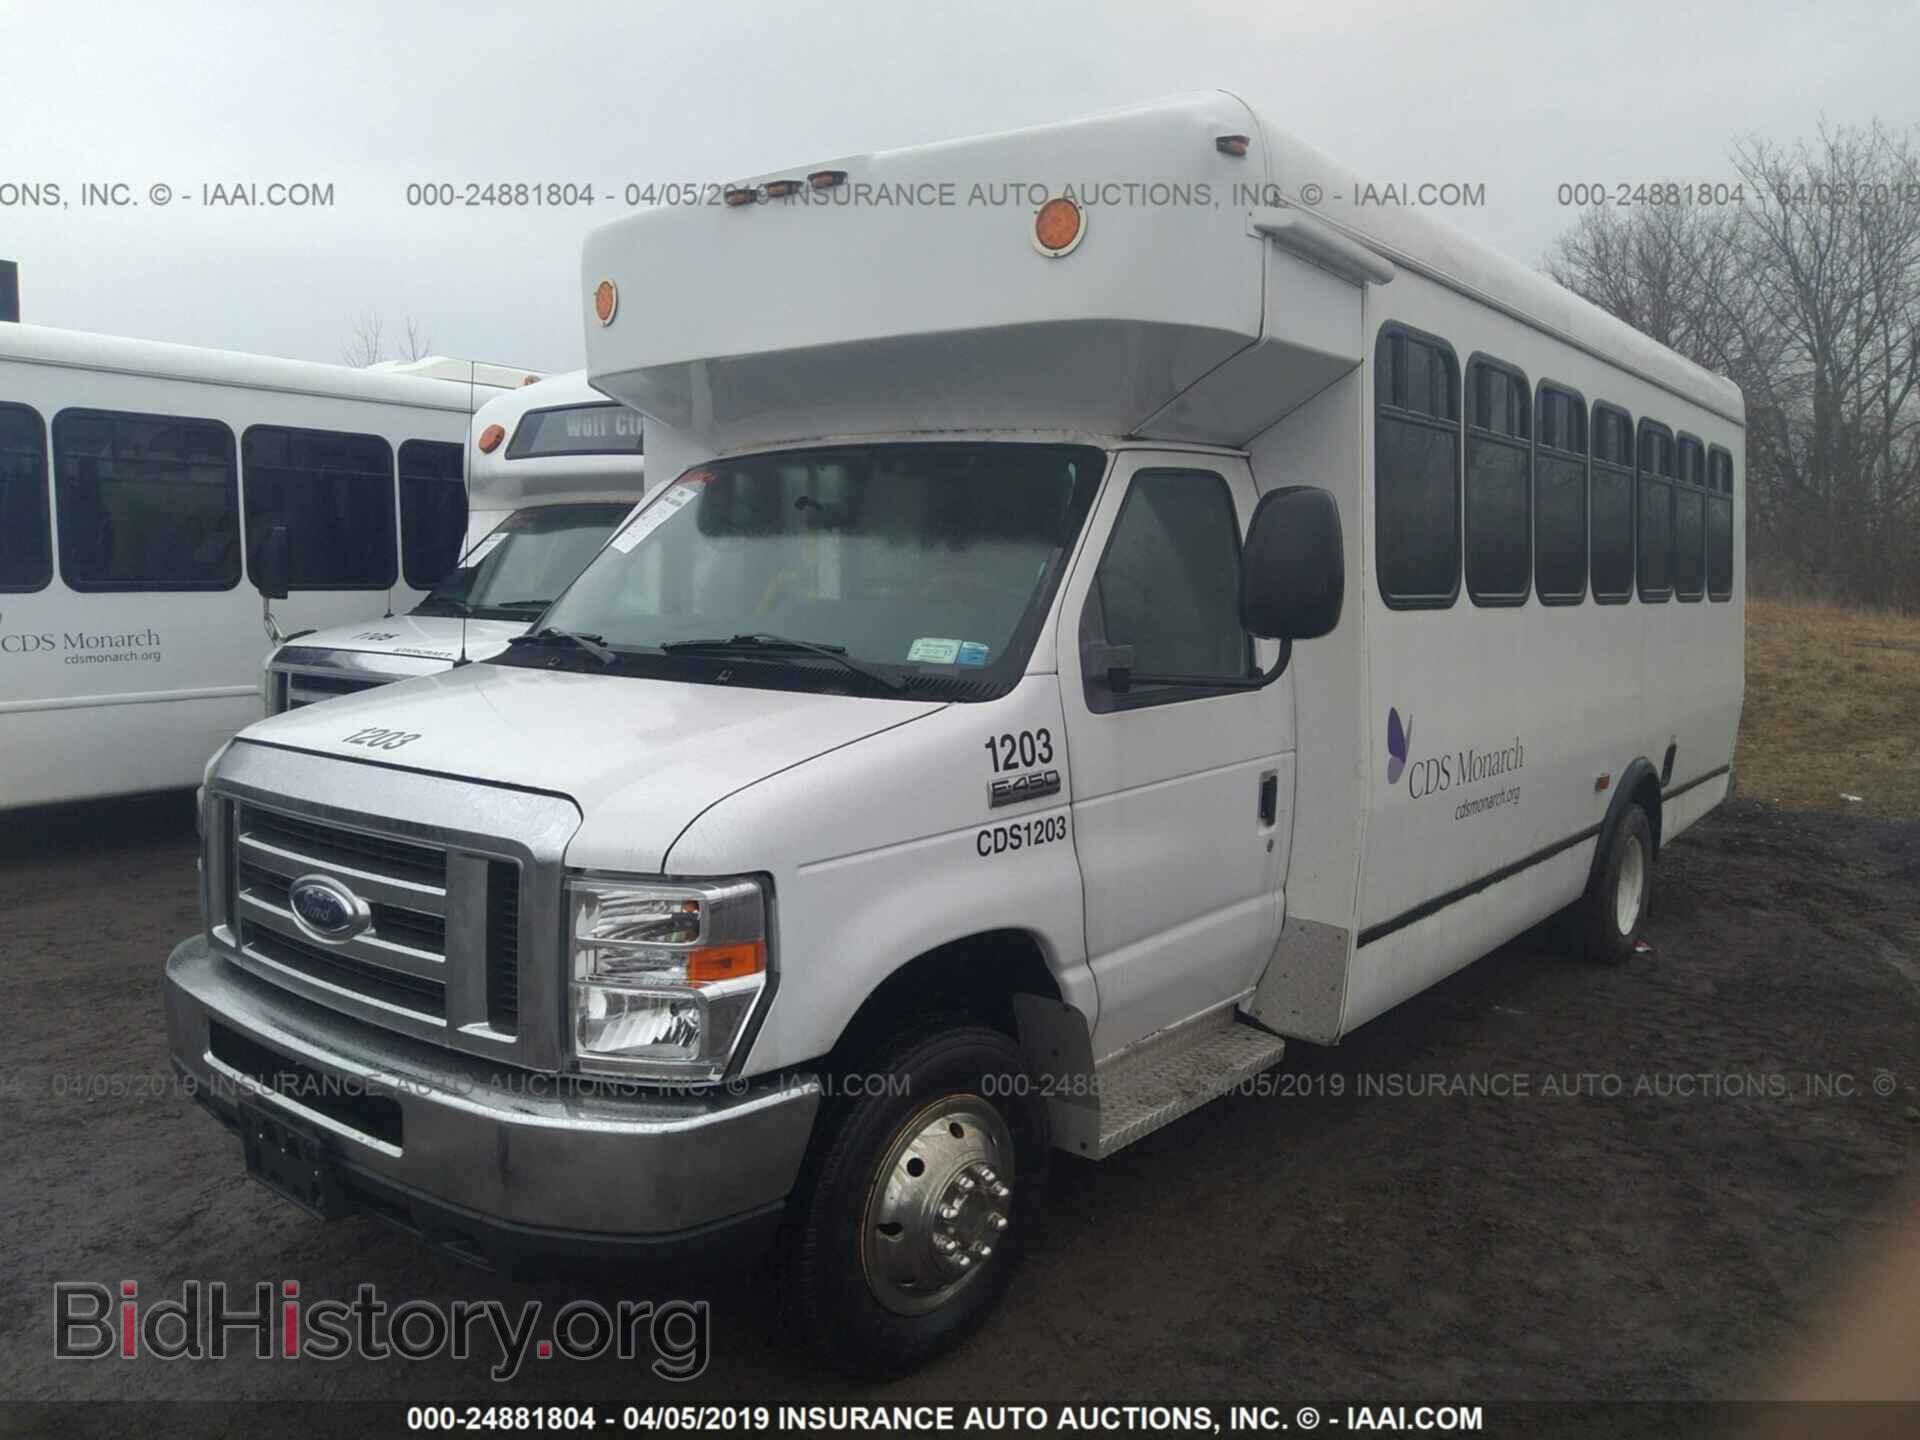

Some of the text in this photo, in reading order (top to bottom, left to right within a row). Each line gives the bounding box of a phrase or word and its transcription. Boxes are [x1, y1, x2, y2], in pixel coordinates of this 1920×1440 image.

[2, 629, 160, 652] CDS Monarch
[64, 650, 161, 664] cdsmonarch.org
[342, 727, 422, 750] 1203
[985, 728, 1053, 772] 1203
[1409, 736, 1523, 799] CDS Monarch
[1455, 786, 1521, 820] cdsmonarch.org
[977, 816, 1066, 857] CDS1203
